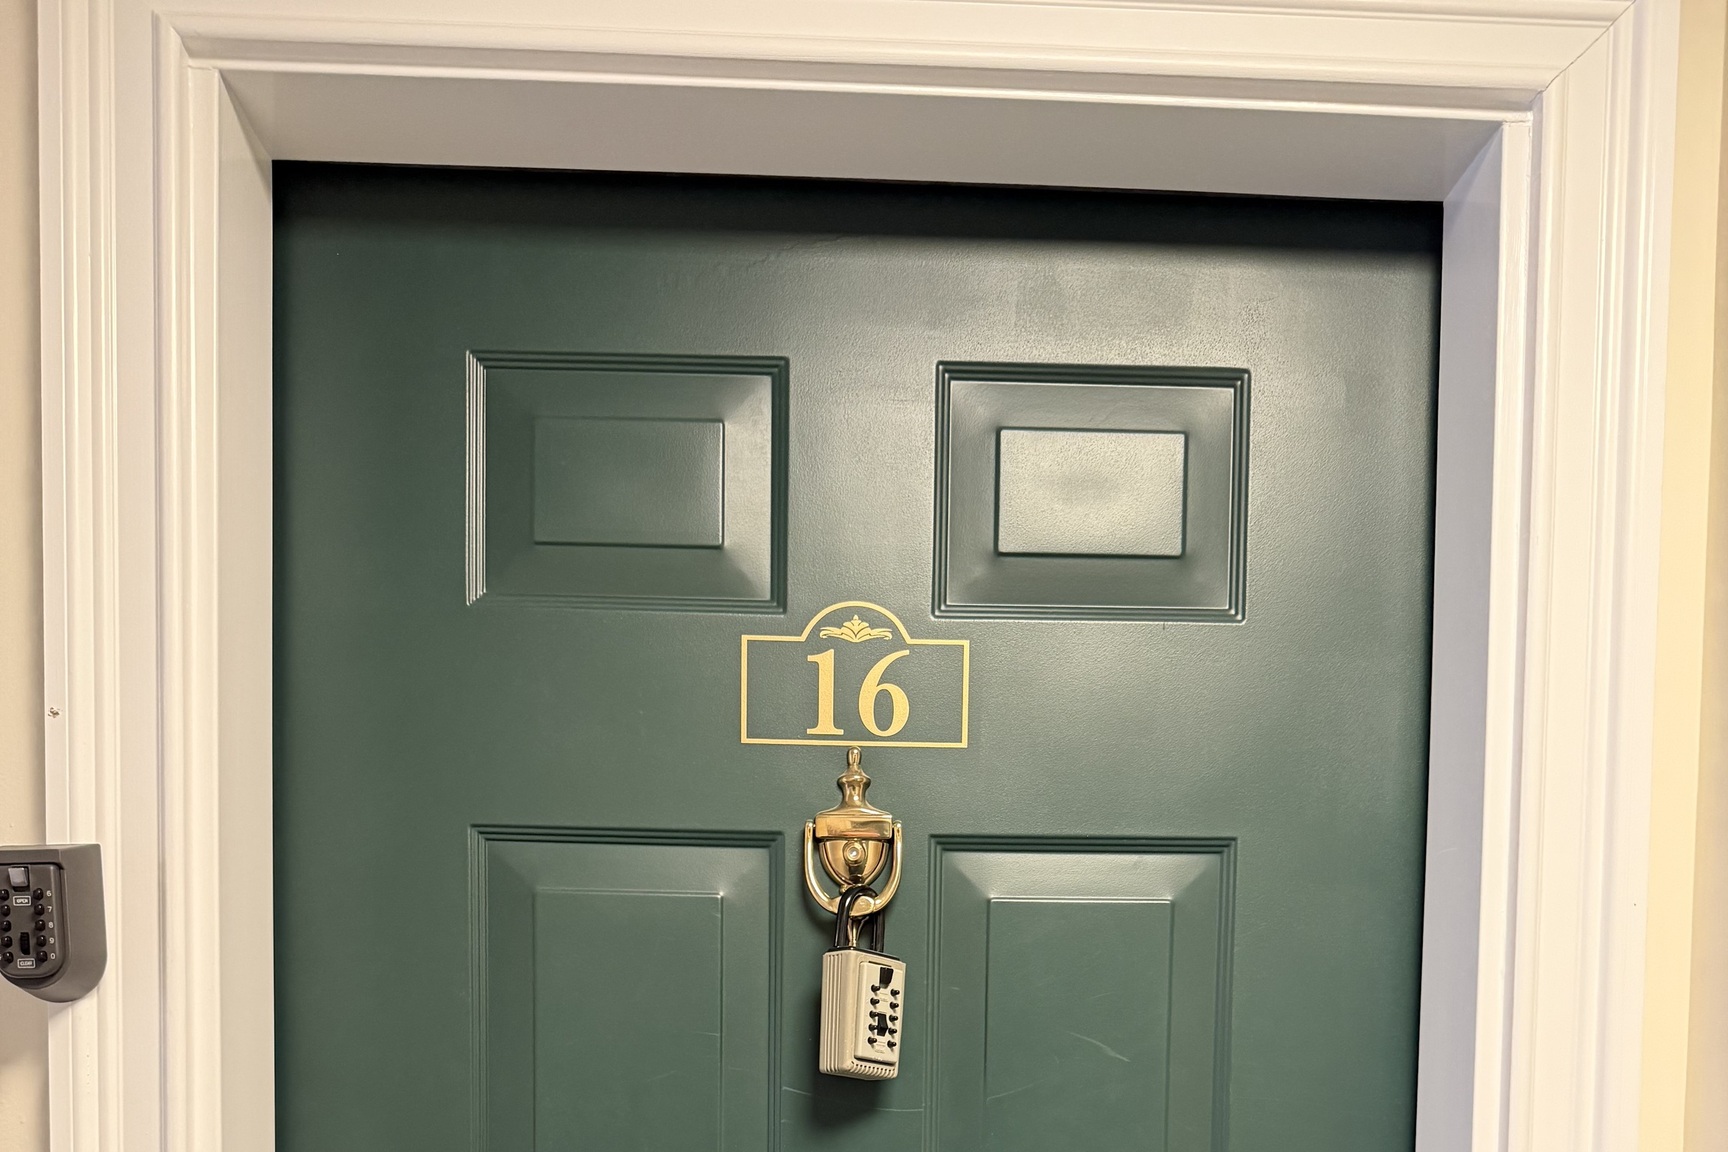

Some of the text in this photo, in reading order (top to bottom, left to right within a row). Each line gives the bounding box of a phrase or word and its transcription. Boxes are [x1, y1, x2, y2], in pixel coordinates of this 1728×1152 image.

[807, 649, 910, 737] 16
[47, 905, 53, 913] 7
[48, 921, 54, 929] 8
